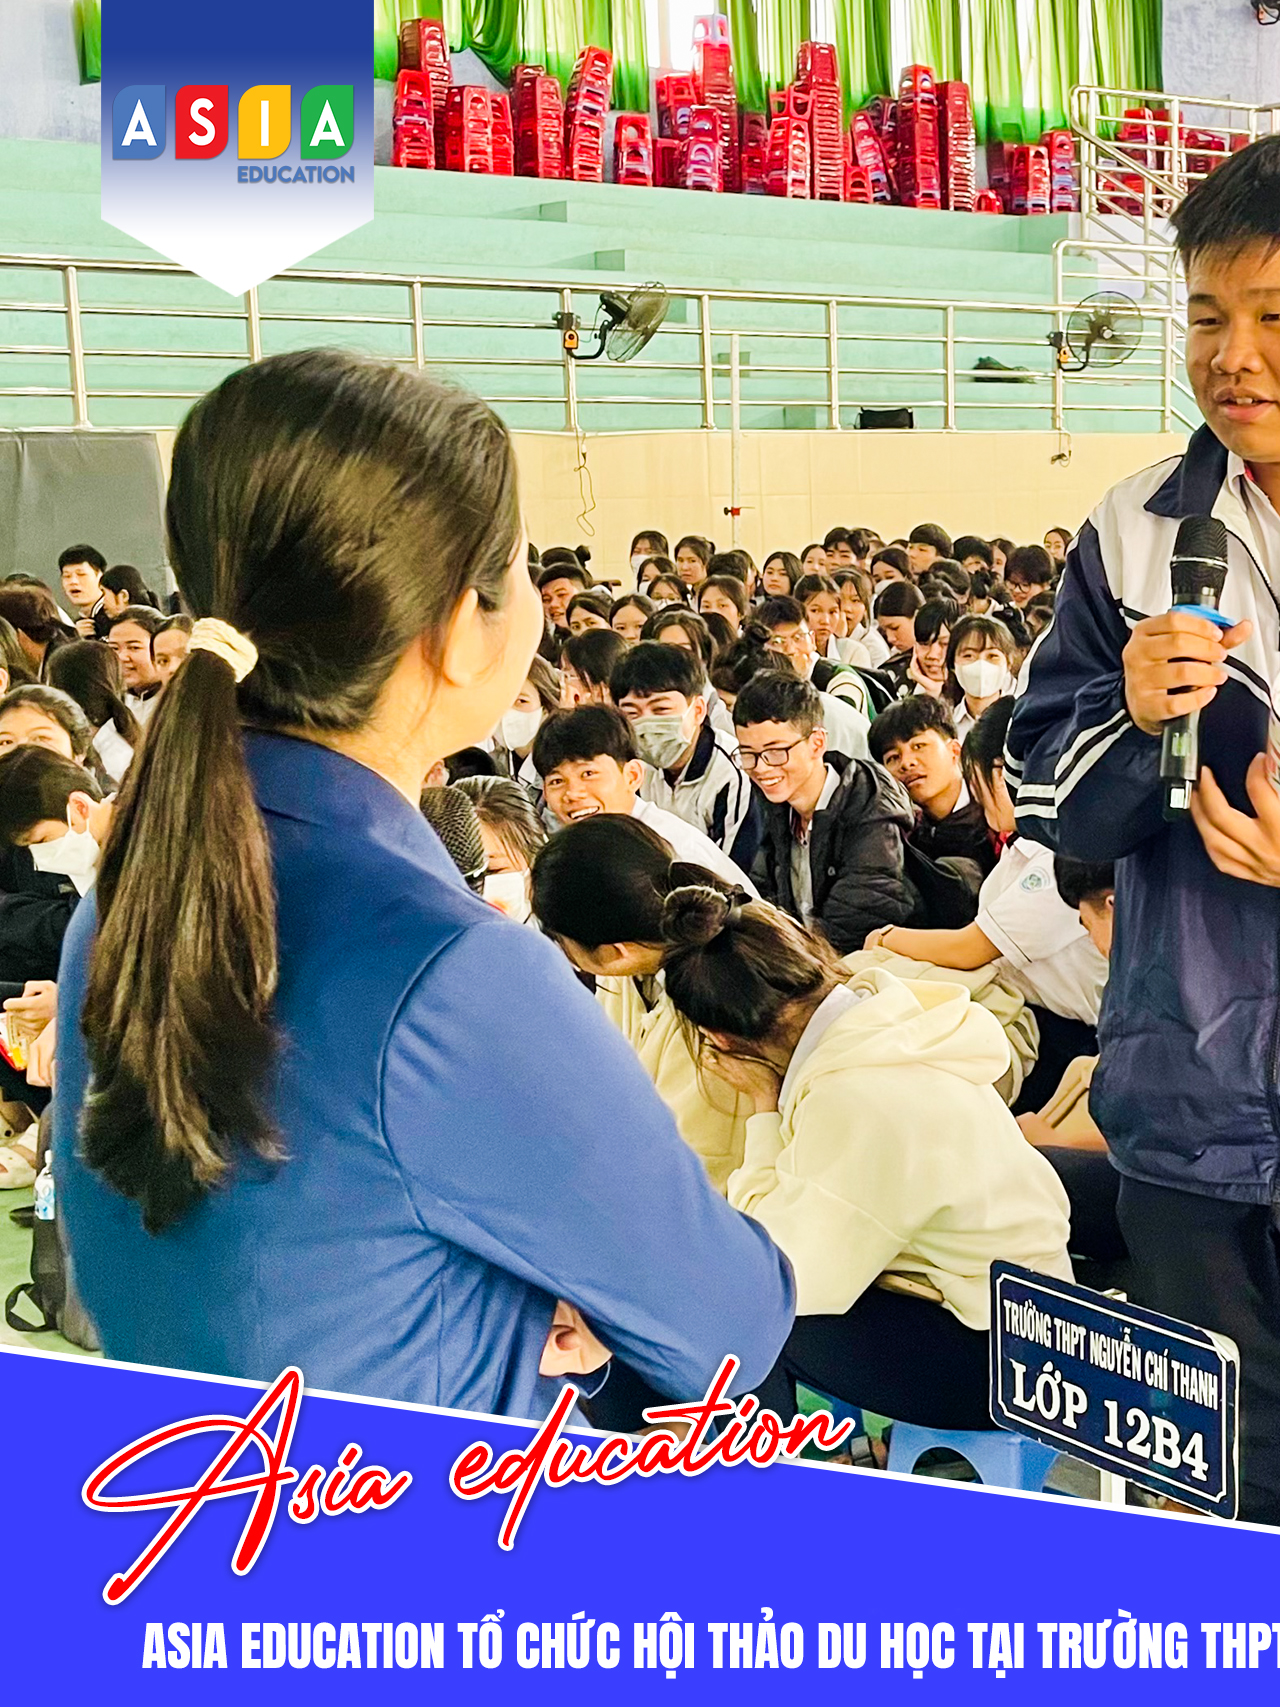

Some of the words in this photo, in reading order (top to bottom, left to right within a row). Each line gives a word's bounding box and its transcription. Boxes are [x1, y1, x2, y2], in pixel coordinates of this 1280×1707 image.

[1003, 1298, 1052, 1348] TRƯỜNG
[1054, 1317, 1087, 1360] THPT
[1089, 1328, 1142, 1381] NGUYỄN
[1144, 1348, 1169, 1392] CHÍ
[1171, 1360, 1218, 1410] THANH
[1009, 1357, 1088, 1429] LỚP
[1104, 1399, 1209, 1482] 12B4
